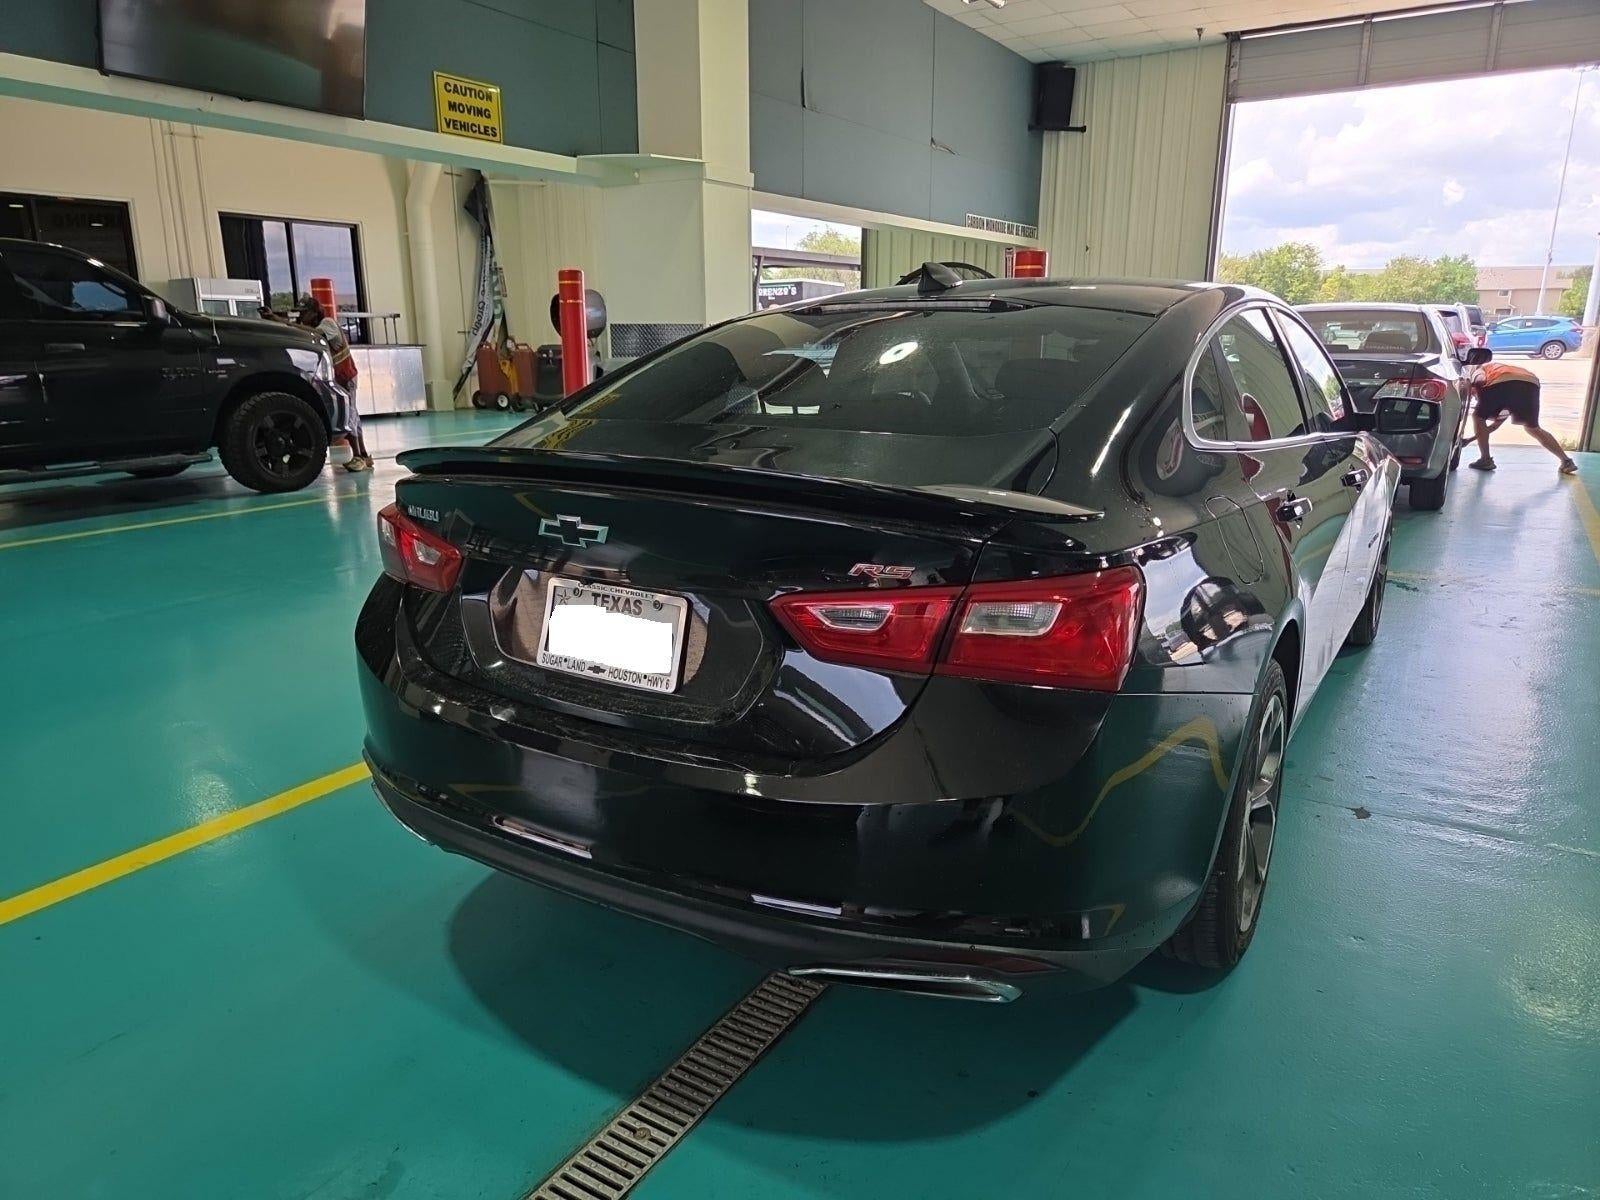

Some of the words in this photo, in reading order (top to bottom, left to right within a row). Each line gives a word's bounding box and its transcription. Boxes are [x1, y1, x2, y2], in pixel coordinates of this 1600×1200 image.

[444, 82, 492, 102] CAUTION
[448, 100, 491, 119] MOVING
[444, 117, 497, 137] VEHICLES
[758, 286, 797, 296] ORENZO'S
[847, 563, 916, 580] RS
[610, 588, 655, 600] CHEVROLET
[592, 592, 643, 616] TEXAS
